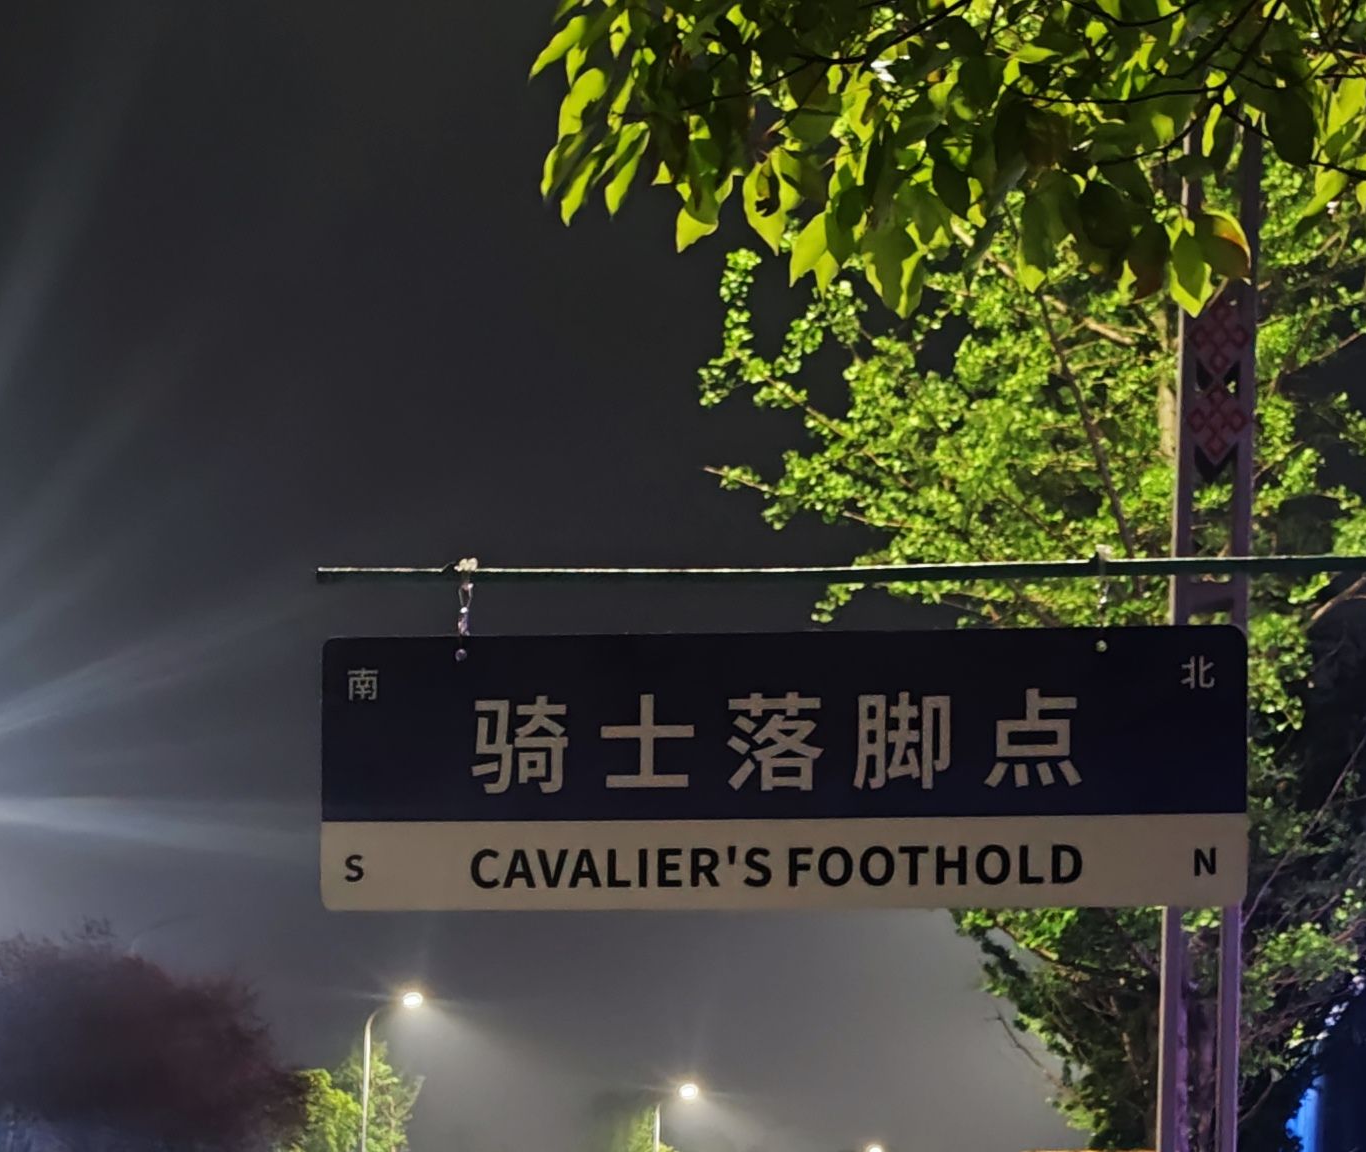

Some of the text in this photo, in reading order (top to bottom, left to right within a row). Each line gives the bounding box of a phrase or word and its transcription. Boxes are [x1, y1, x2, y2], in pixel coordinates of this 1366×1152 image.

[346, 666, 380, 702] 南
[1180, 655, 1217, 690] 北
[471, 687, 1083, 795] 骑士落脚点
[343, 853, 365, 883] S
[469, 843, 1084, 890] CAVALIER'S FOOTHOLD
[1192, 846, 1218, 877] N
